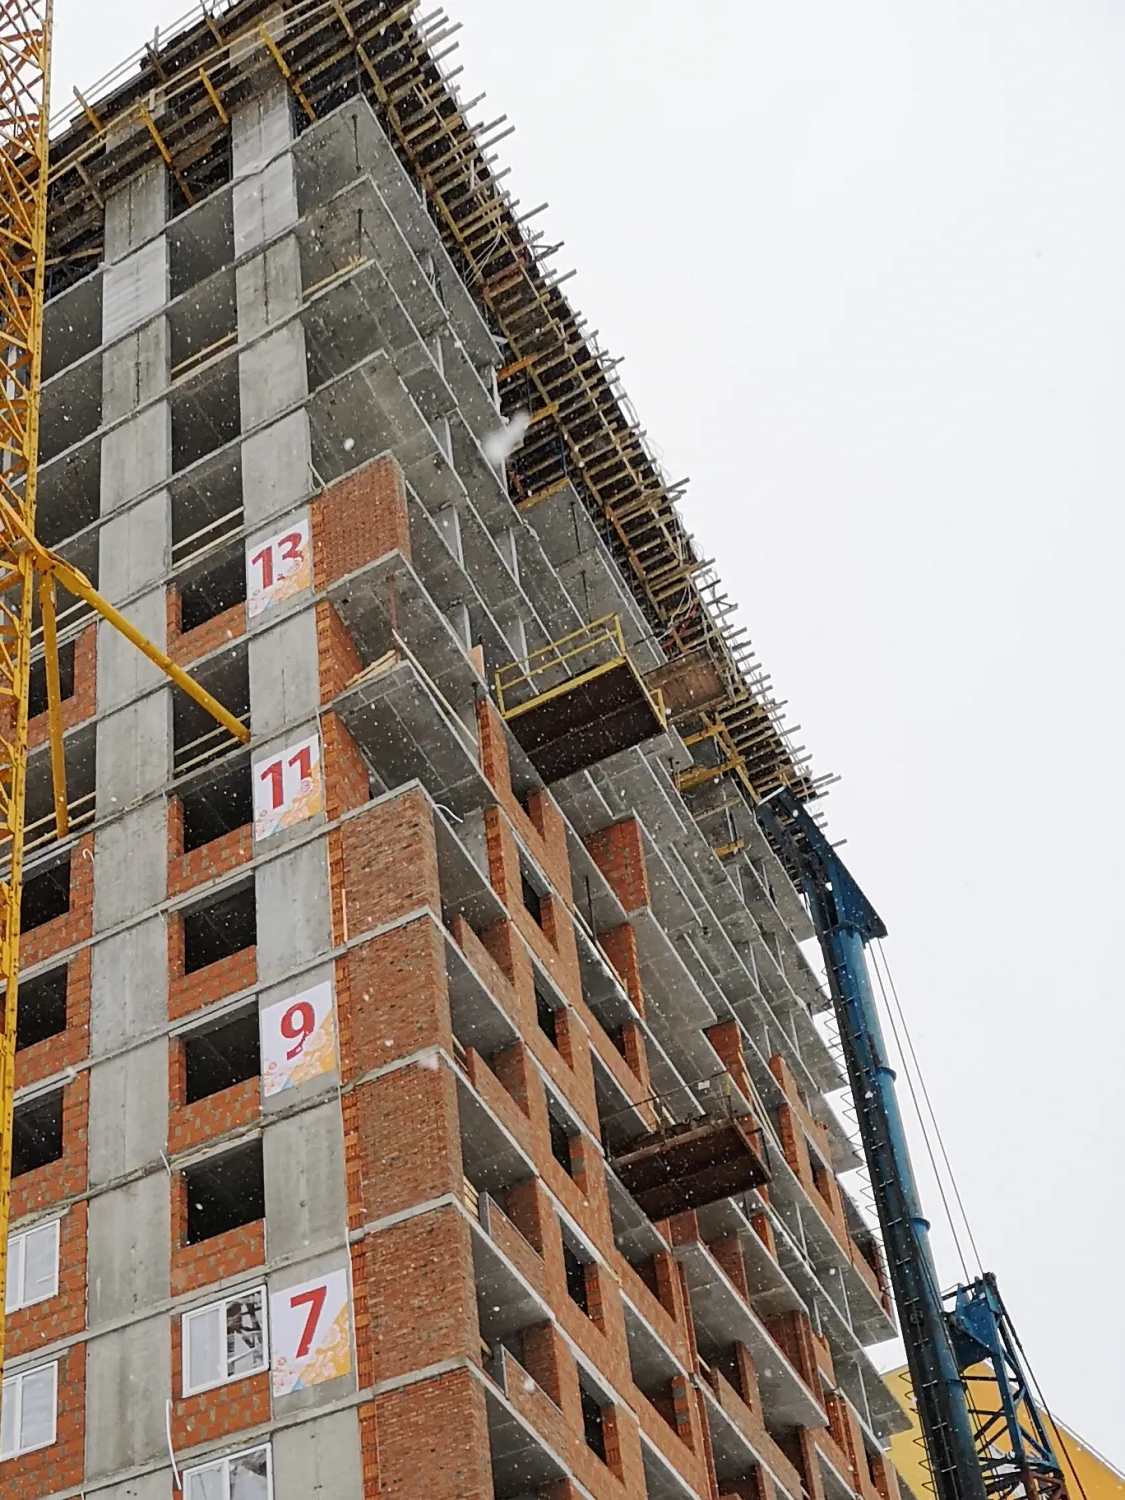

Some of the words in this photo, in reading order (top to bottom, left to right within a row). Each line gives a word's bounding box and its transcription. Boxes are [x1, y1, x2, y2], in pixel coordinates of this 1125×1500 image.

[252, 532, 304, 589] 13
[260, 745, 311, 809] 11
[280, 1002, 315, 1060] 9
[290, 1286, 327, 1360] 7
